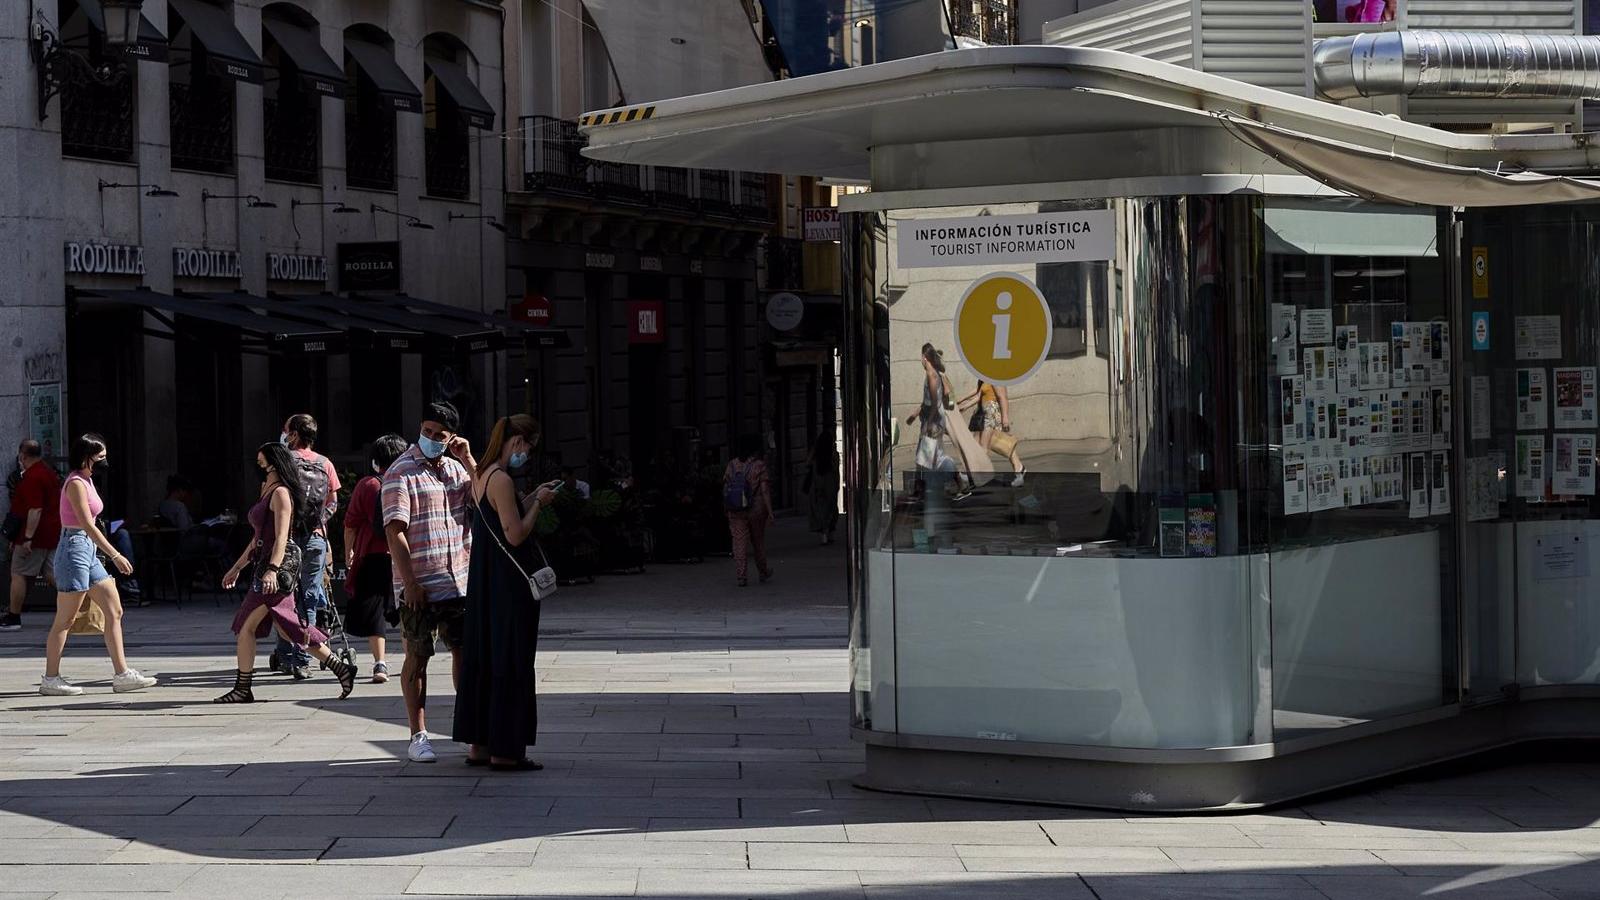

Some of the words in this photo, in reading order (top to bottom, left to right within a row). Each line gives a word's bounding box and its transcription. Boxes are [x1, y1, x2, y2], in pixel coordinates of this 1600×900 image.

[915, 224, 1012, 241] INFORMACIÓN
[1016, 221, 1092, 237] TURÍSTICA
[68, 242, 146, 275] RODILLA
[930, 242, 983, 256] TOURIST
[986, 238, 1076, 254] INFORMATION
[177, 248, 243, 279] RODILLA
[270, 253, 329, 281] RODILLA
[344, 260, 394, 271] RODILLA
